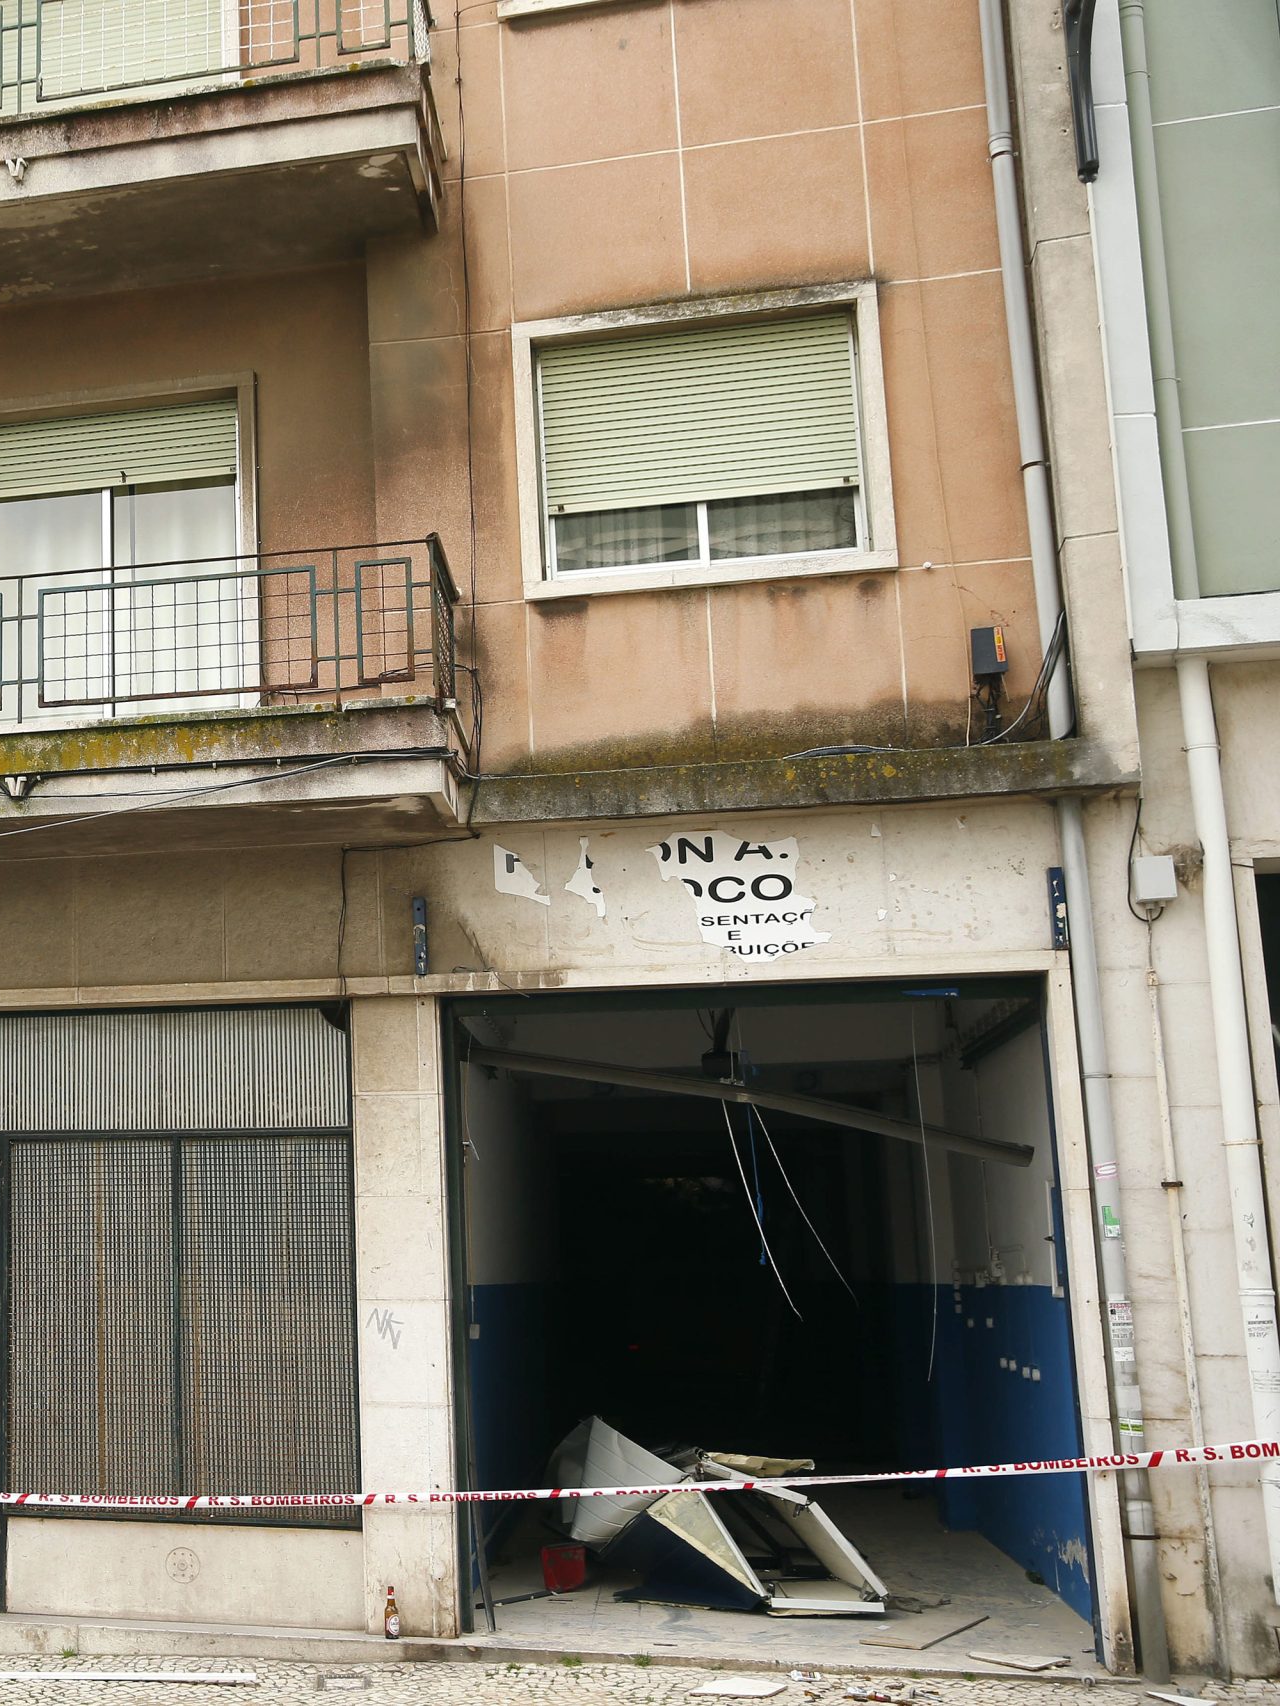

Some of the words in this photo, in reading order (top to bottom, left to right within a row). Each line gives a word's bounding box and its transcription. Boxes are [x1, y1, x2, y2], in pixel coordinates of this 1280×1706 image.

[728, 930, 742, 941] E
[1175, 1448, 1197, 1462] R.
[1203, 1446, 1224, 1461] S.
[1013, 1454, 1139, 1472] BOMBEIROS
[39, 1493, 54, 1502] R.
[59, 1494, 74, 1503] S.
[80, 1494, 179, 1506] BOMBEIROS
[208, 1496, 224, 1506] R.
[230, 1496, 245, 1506] S.
[251, 1494, 355, 1506] BOMBEIROS
[429, 1491, 538, 1503] BOMBEIROS
